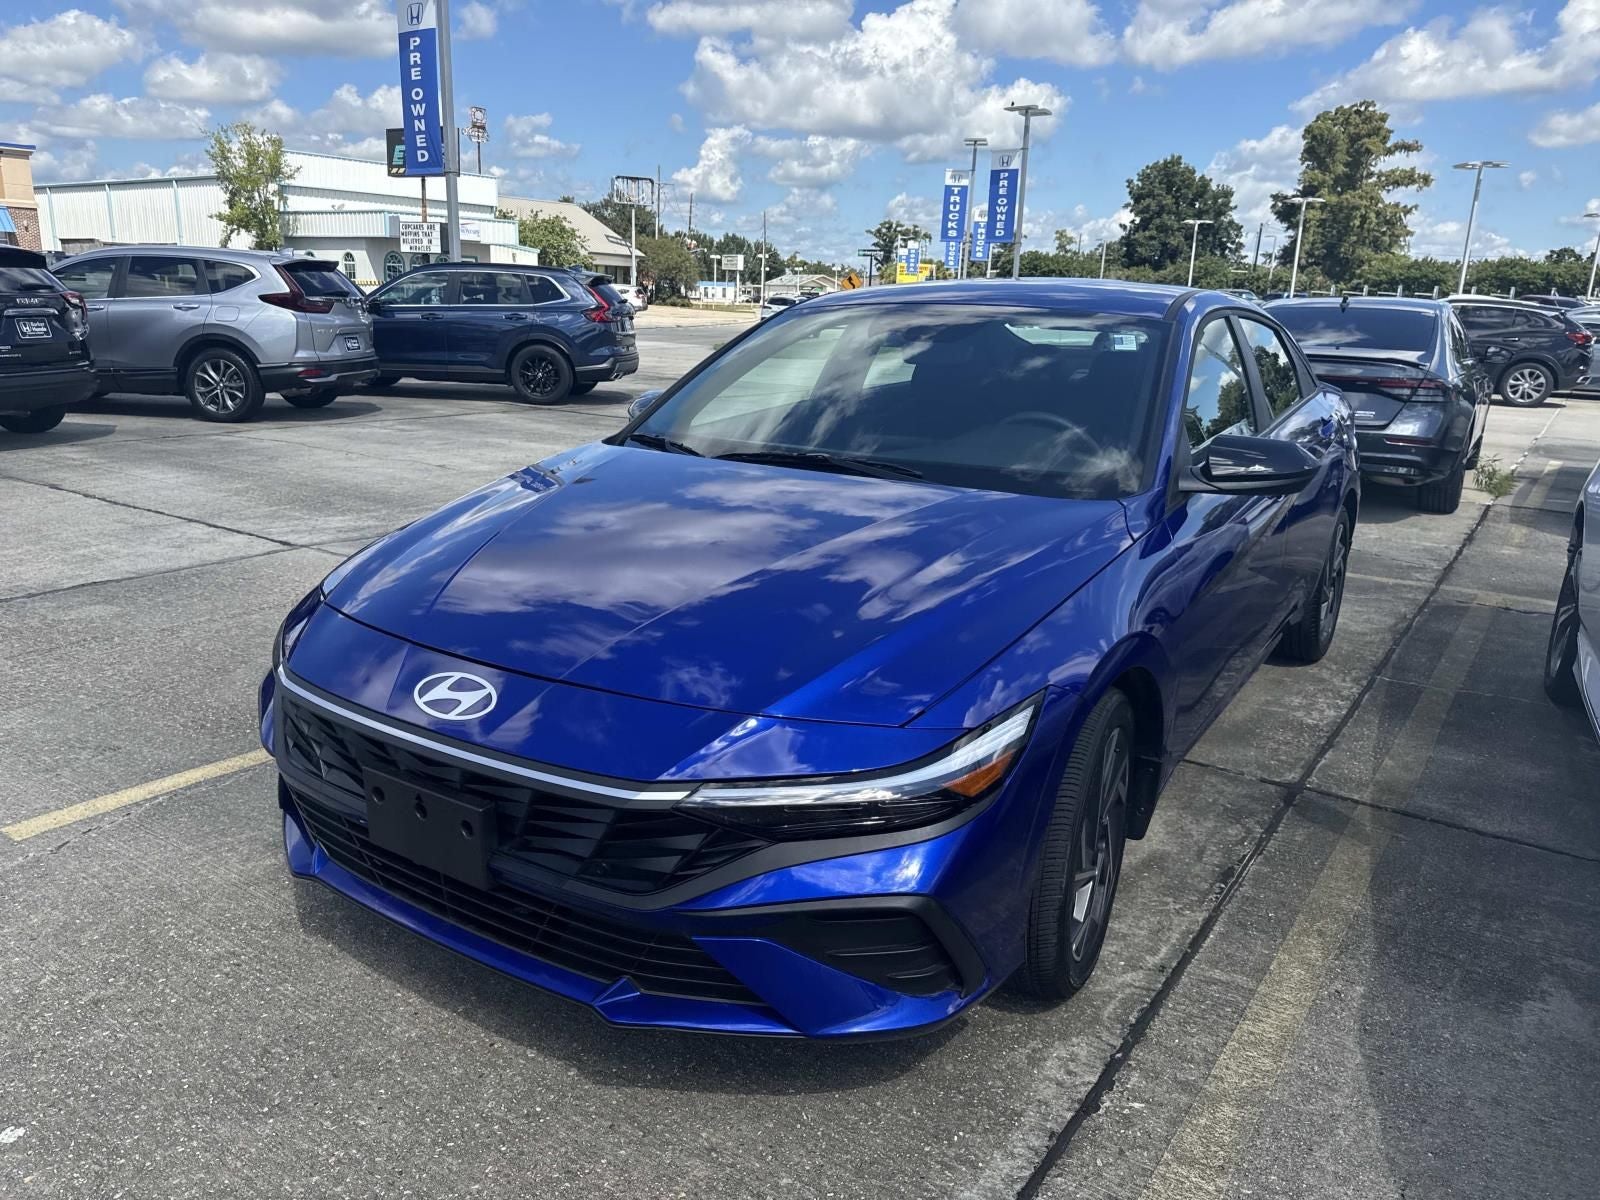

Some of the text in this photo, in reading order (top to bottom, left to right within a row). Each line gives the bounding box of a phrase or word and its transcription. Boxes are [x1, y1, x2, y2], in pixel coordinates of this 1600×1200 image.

[410, 37, 428, 162] PRE OWNED
[947, 187, 961, 237] TRUCKS
[995, 172, 1008, 236] PRE OWNED
[975, 222, 986, 258] TRUCKS
